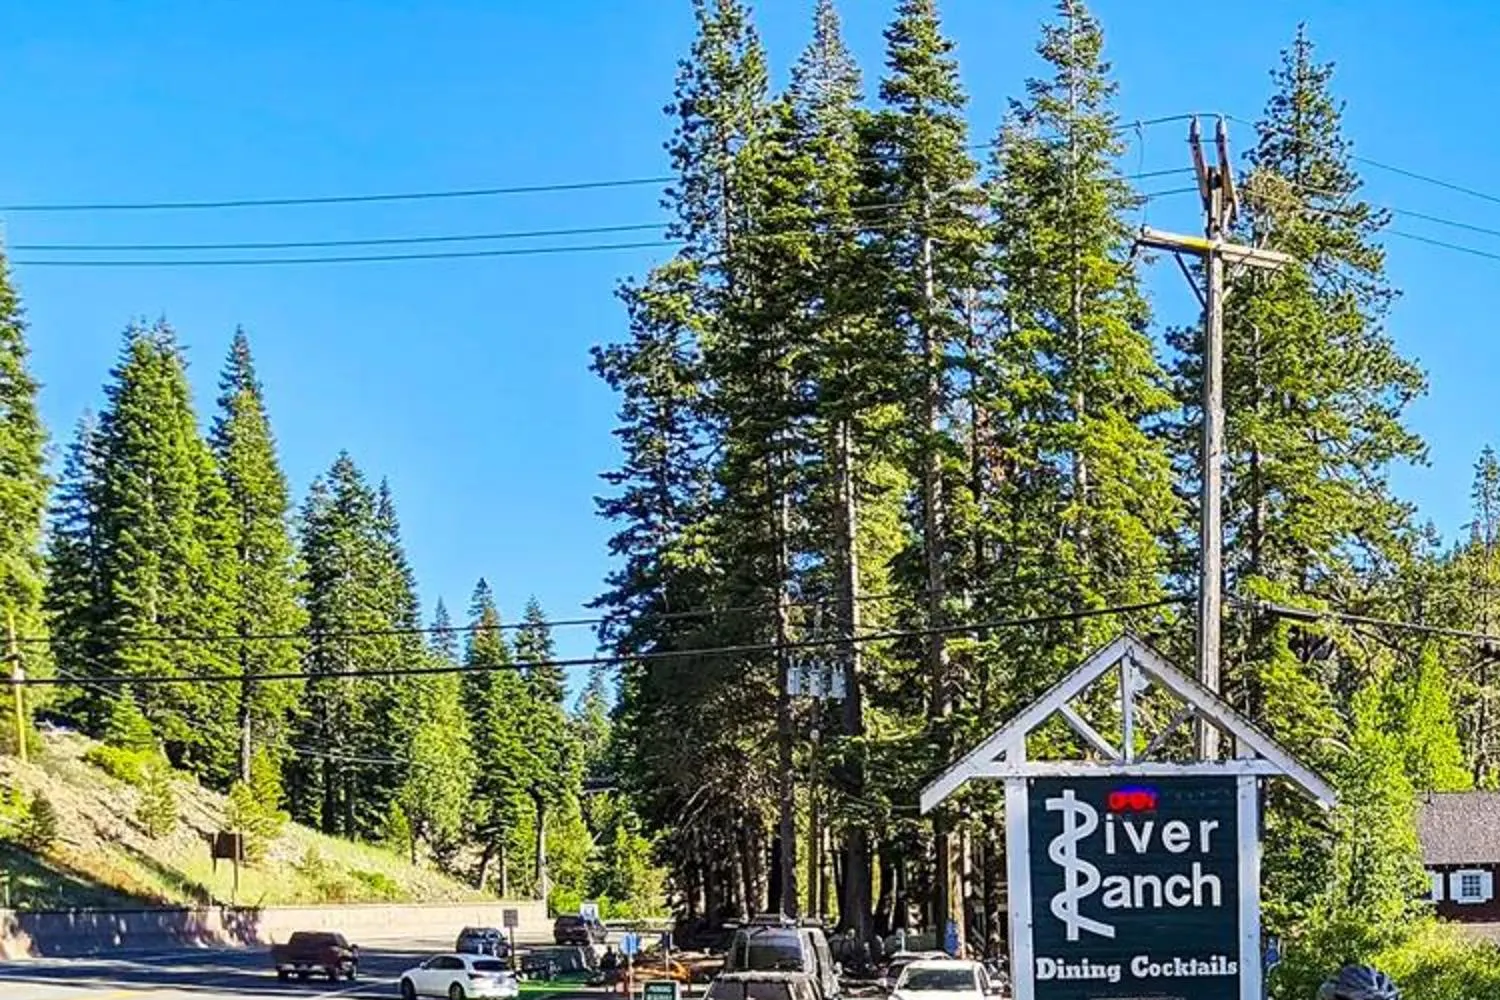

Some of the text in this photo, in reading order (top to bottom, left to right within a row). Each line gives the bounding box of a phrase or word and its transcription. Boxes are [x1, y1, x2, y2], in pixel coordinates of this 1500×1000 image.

[1045, 789, 1219, 862] River
[1050, 860, 1222, 941] Ranch
[1036, 955, 1238, 982] Dining Cocktails
